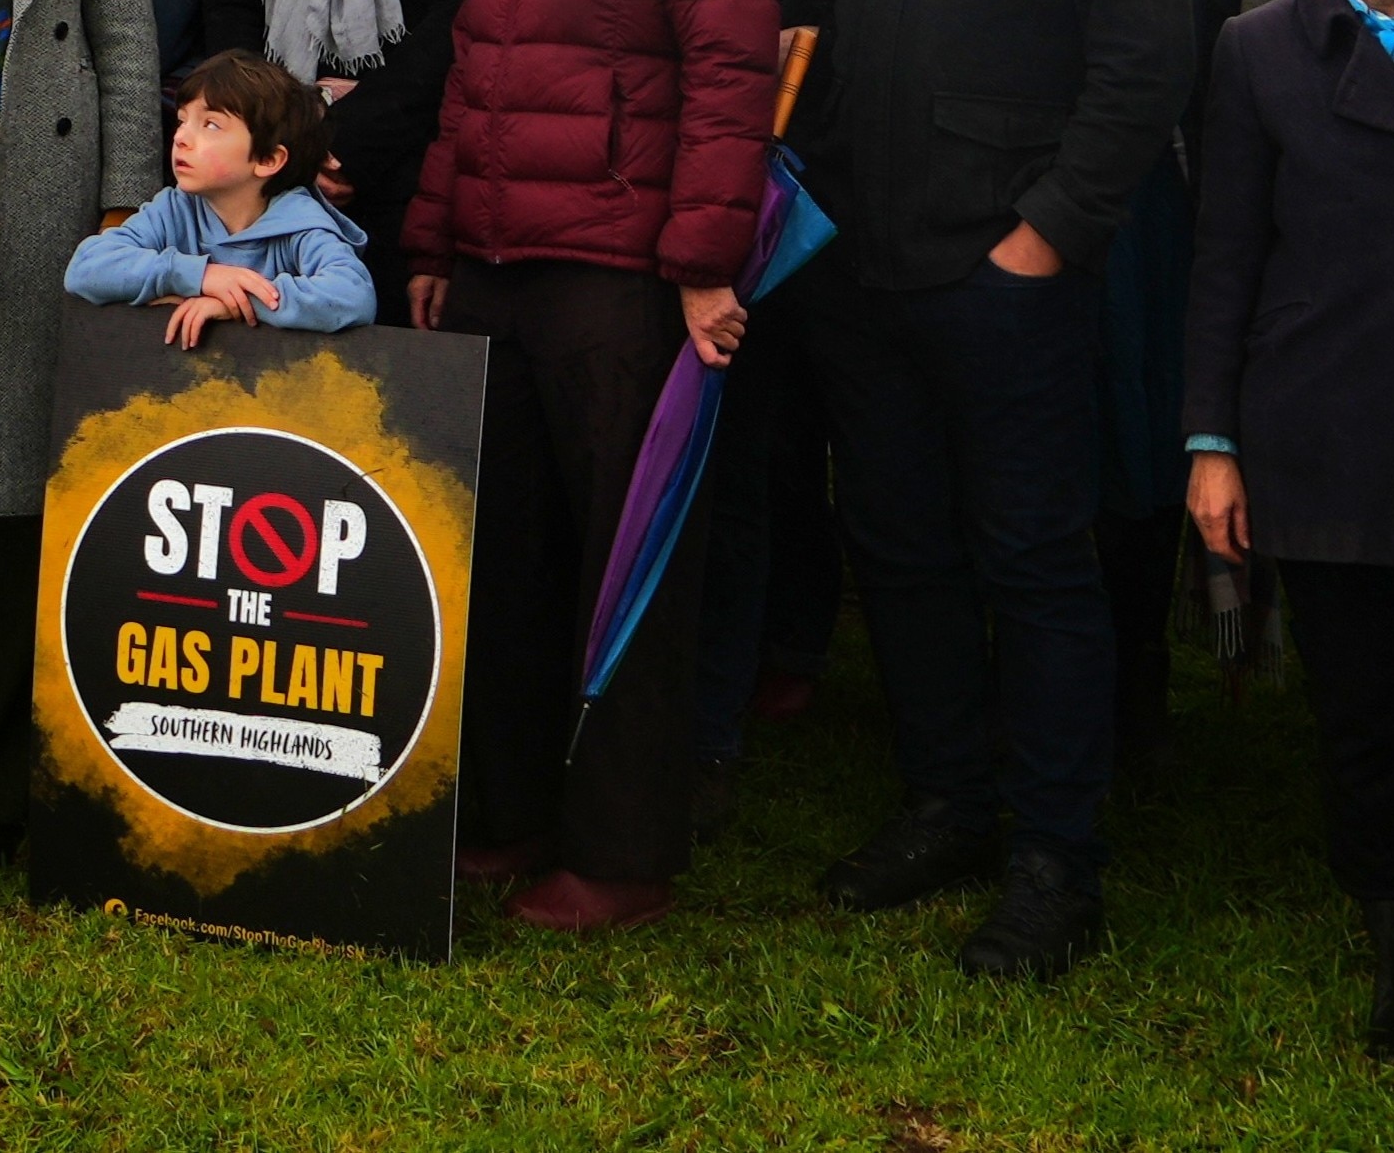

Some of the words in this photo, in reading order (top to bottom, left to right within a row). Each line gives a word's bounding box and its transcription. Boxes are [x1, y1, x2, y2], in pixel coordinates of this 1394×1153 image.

[145, 480, 366, 595] STOP
[228, 589, 272, 626] THE
[117, 622, 211, 693] GAS
[229, 636, 384, 718] PLANT
[150, 714, 233, 745] SOUTHERN
[240, 726, 333, 760] HIGHLANDS
